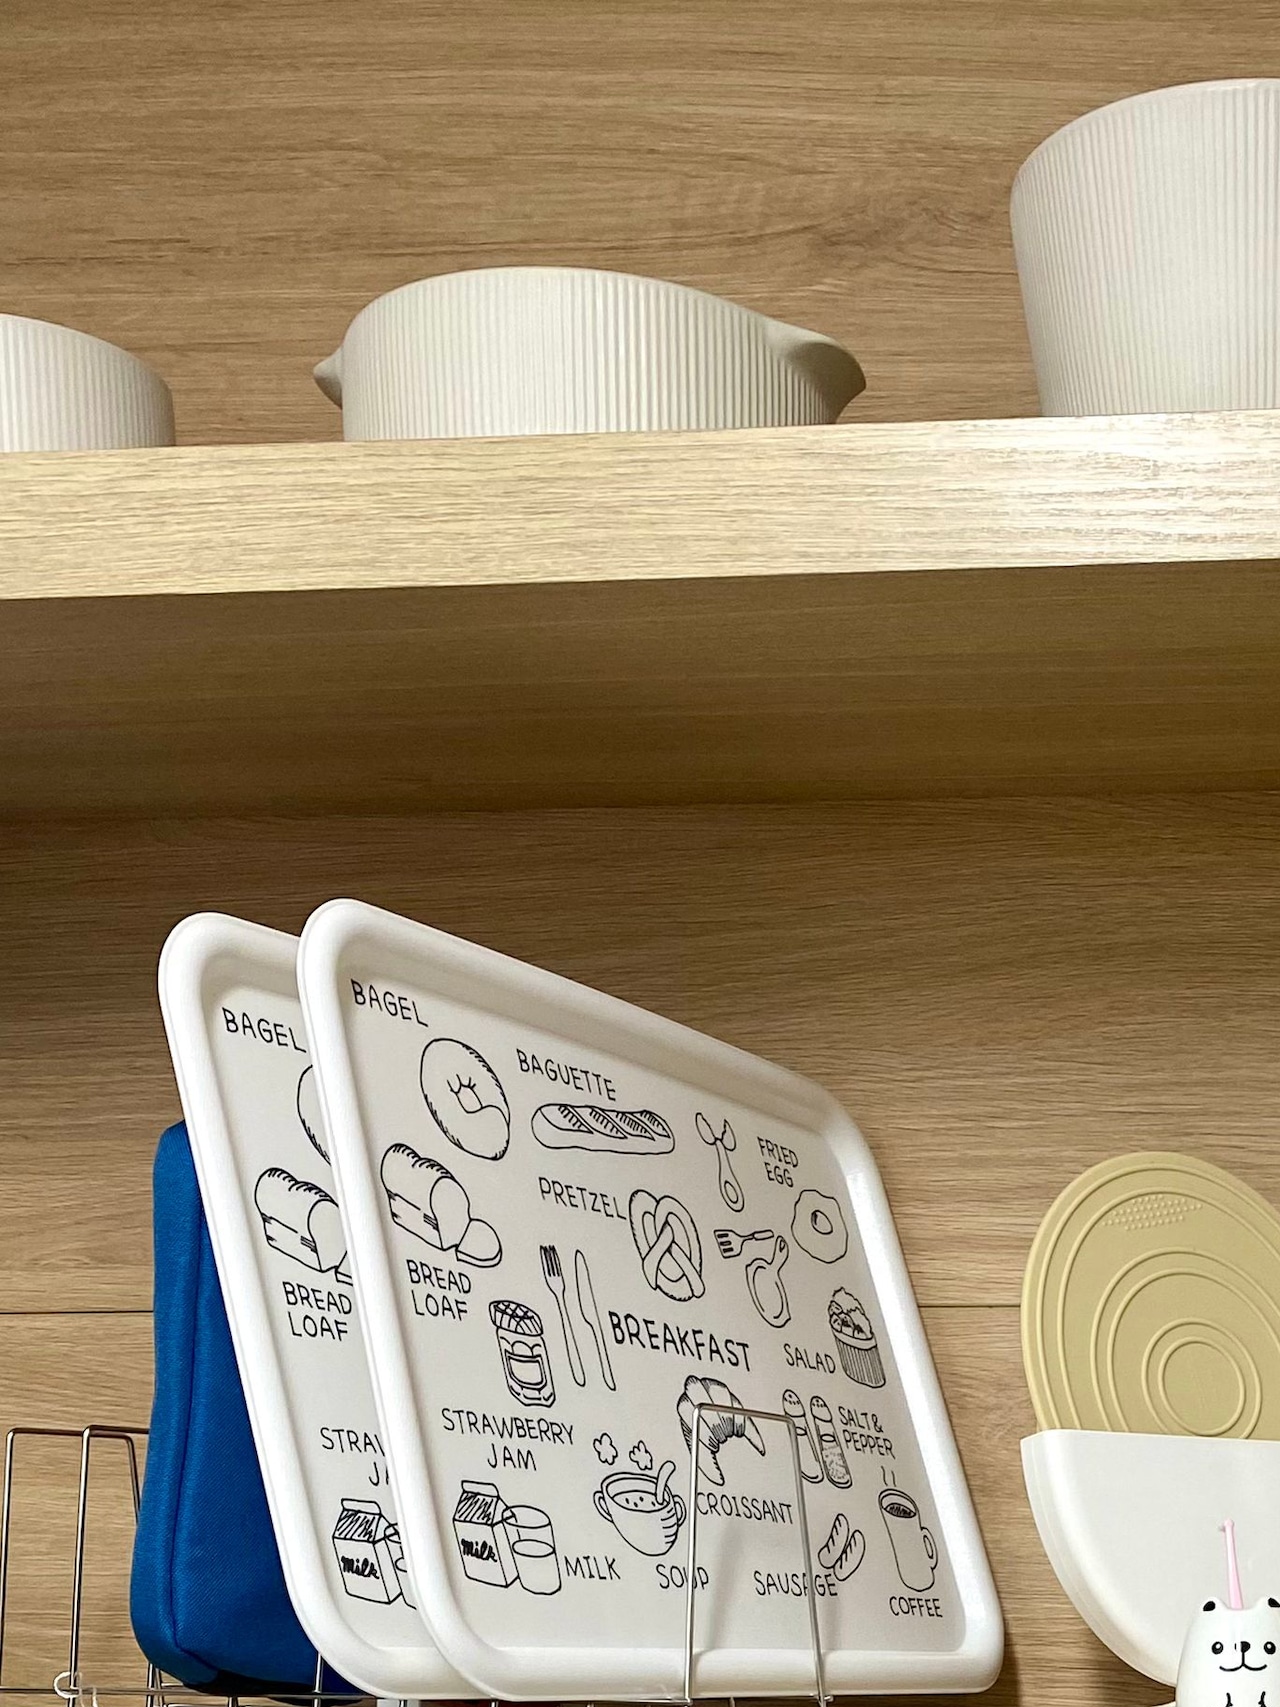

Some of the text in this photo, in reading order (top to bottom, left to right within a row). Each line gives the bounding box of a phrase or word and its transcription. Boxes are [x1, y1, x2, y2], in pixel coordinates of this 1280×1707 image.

[350, 978, 429, 1027] BAGEL
[222, 1007, 307, 1053] BAGEL
[516, 1048, 617, 1102] BAGUETTE
[756, 1136, 799, 1168] FRIED
[764, 1161, 794, 1188] EGG
[538, 1176, 627, 1221] PRETZEL
[406, 1259, 472, 1294] BREAD
[282, 1281, 352, 1315] BREAD
[411, 1289, 468, 1321] LOAF
[287, 1311, 349, 1341] LOAF
[608, 1310, 751, 1372] BREAKFAST
[783, 1342, 837, 1375] SALAD
[441, 1408, 575, 1446] STRAWBERRY
[487, 1443, 537, 1471] JAM
[842, 1429, 896, 1460] PEPPER
[696, 1491, 794, 1525] CROISSANT
[564, 1555, 621, 1581] MILK
[889, 1596, 943, 1619] COFFEE
